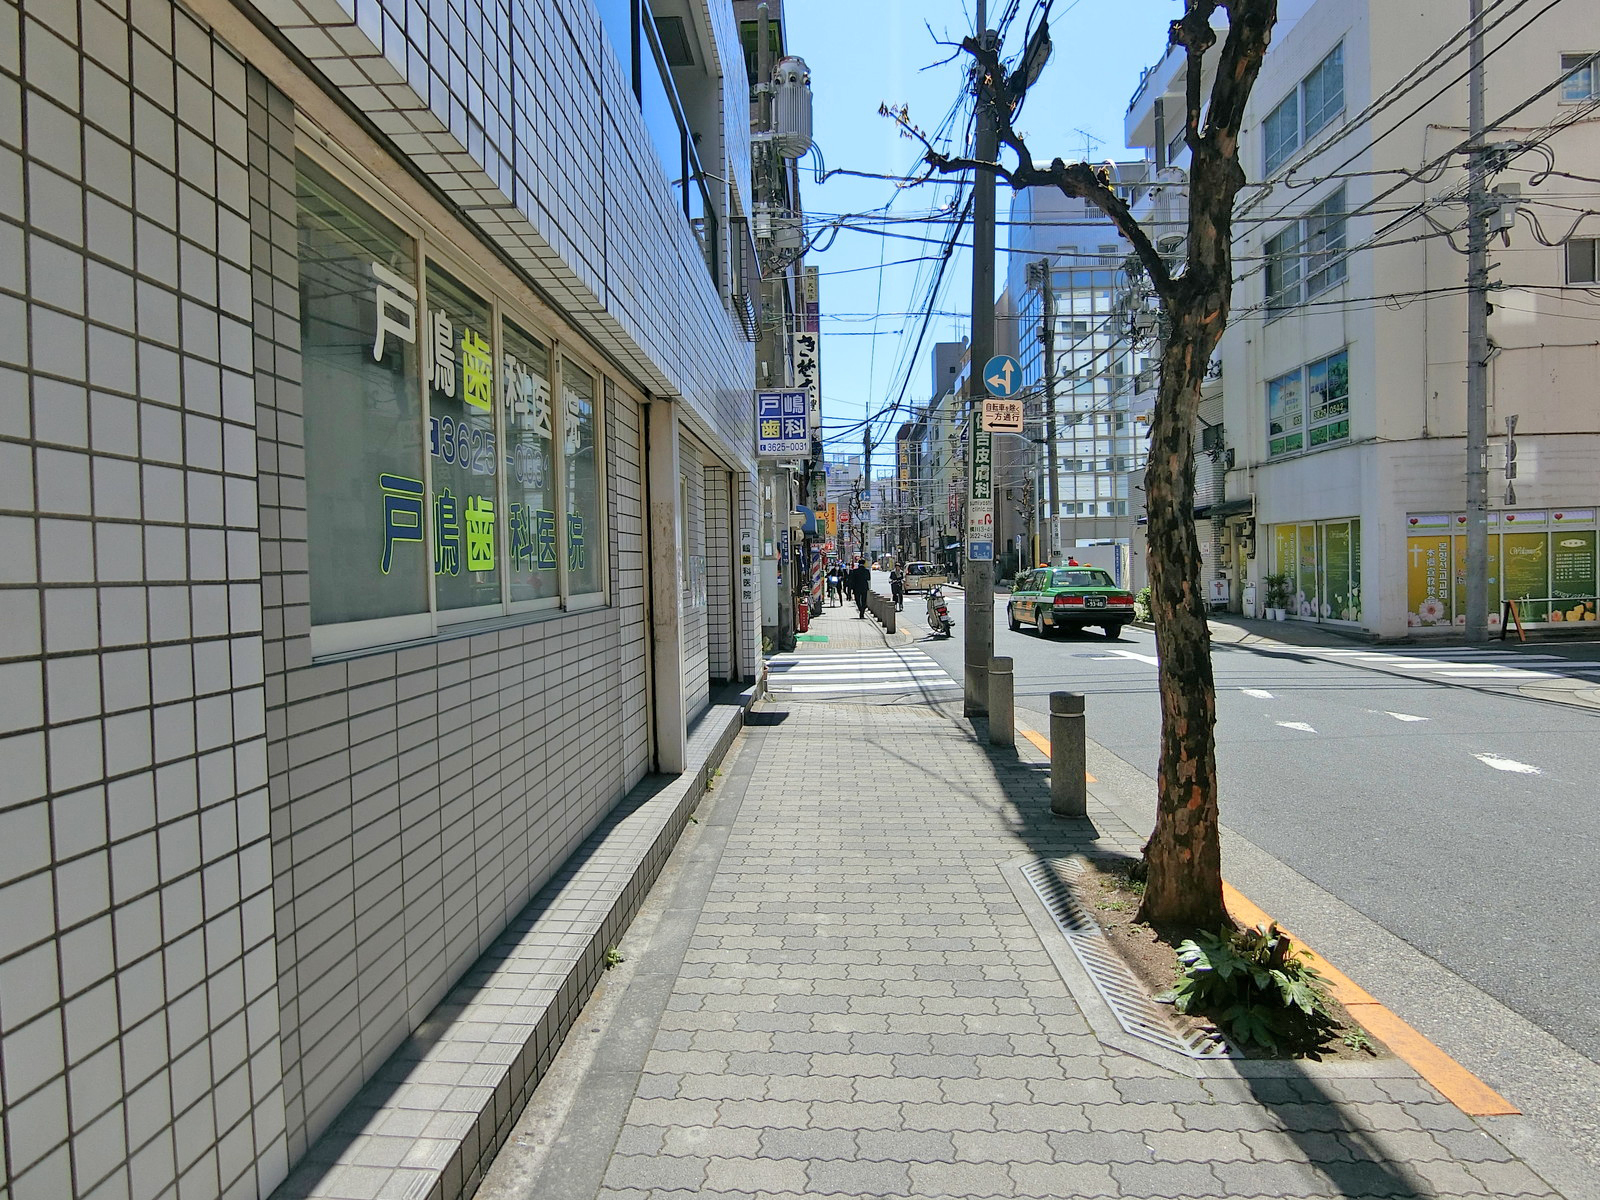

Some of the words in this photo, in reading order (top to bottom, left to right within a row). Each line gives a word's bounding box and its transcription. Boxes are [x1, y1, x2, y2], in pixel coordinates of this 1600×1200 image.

[372, 262, 581, 450] 戸嶋歯科医院
[761, 395, 804, 414] 戸嶋
[985, 402, 1019, 412] 自転車を除く
[986, 412, 1019, 422] 一方通行
[761, 420, 805, 438] 歯科
[440, 415, 552, 493] 3625-0031
[767, 442, 807, 453] 3625-0031
[380, 472, 585, 576] 戸嶋歯科医院
